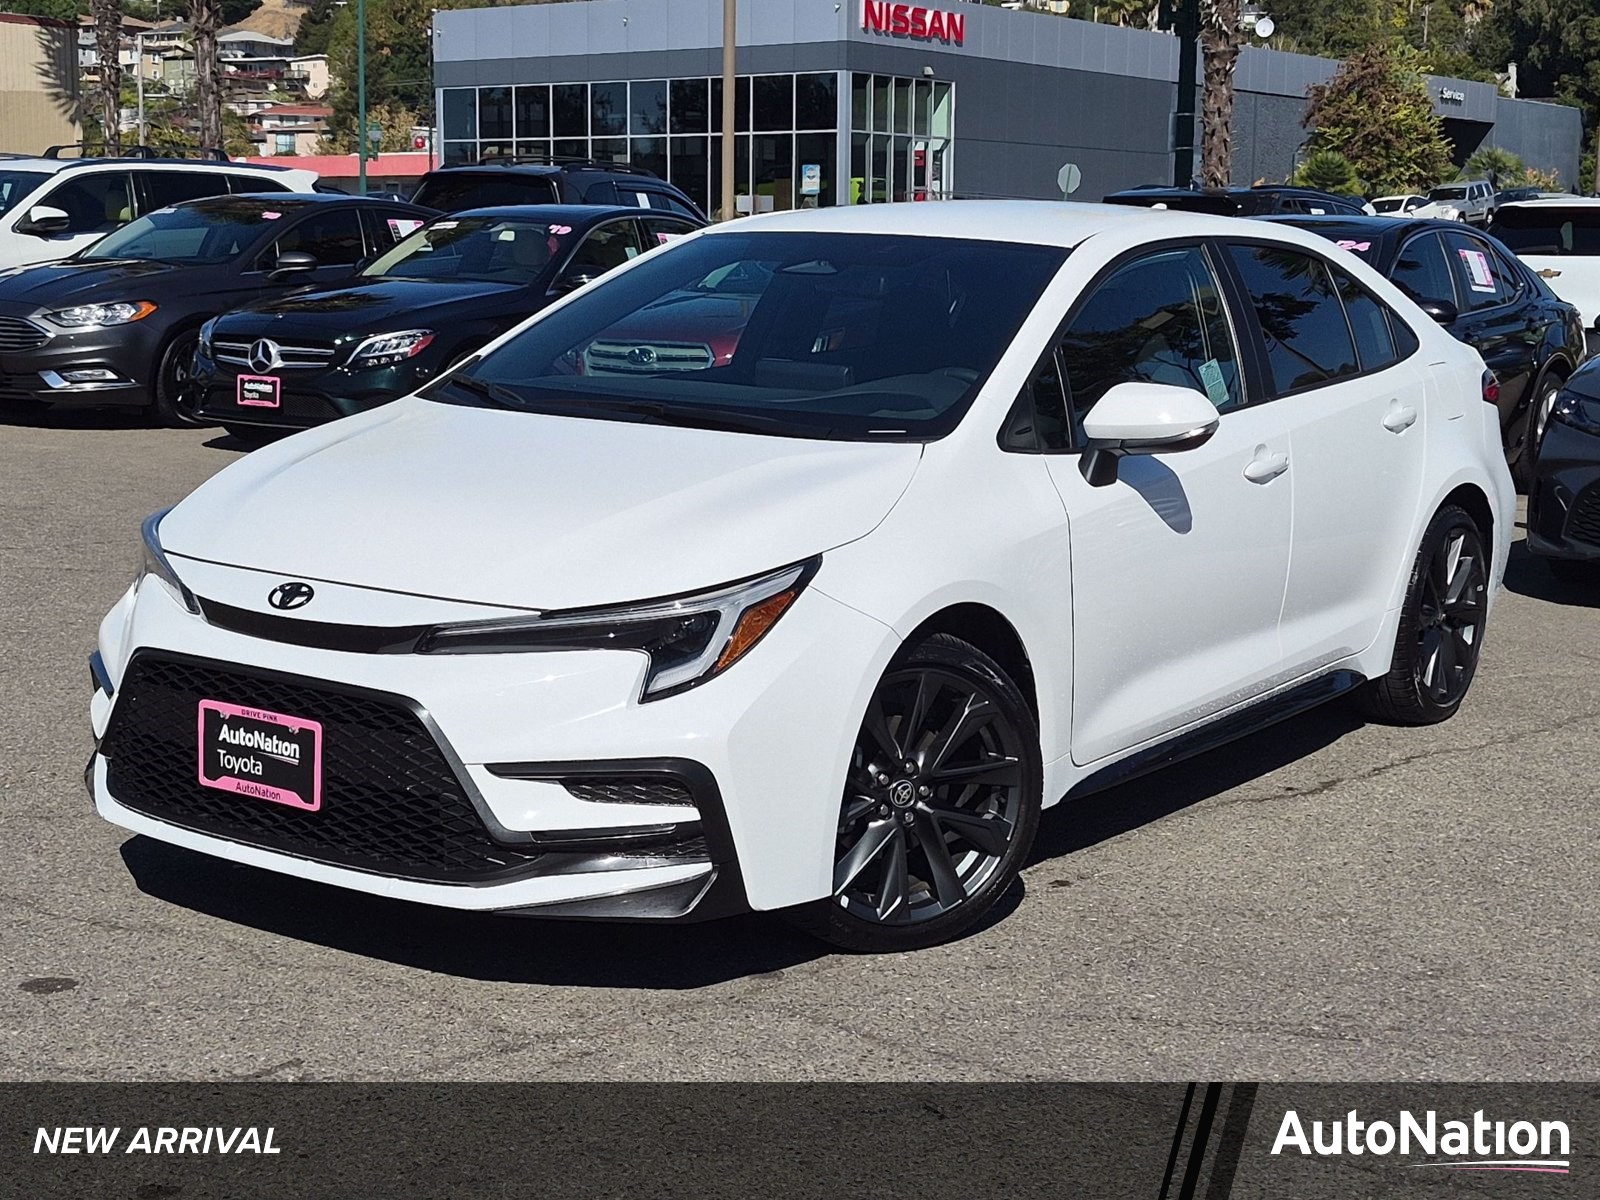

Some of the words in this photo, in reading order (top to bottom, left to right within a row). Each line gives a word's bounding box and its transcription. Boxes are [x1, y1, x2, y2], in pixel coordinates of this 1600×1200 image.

[863, 0, 965, 44] NISSAN
[1442, 87, 1465, 101] Service
[241, 708, 261, 719] DRIVE
[262, 713, 278, 722] PINK
[218, 723, 300, 758] AutoNation
[217, 749, 263, 775] Toyota
[235, 782, 281, 801] AutoNation
